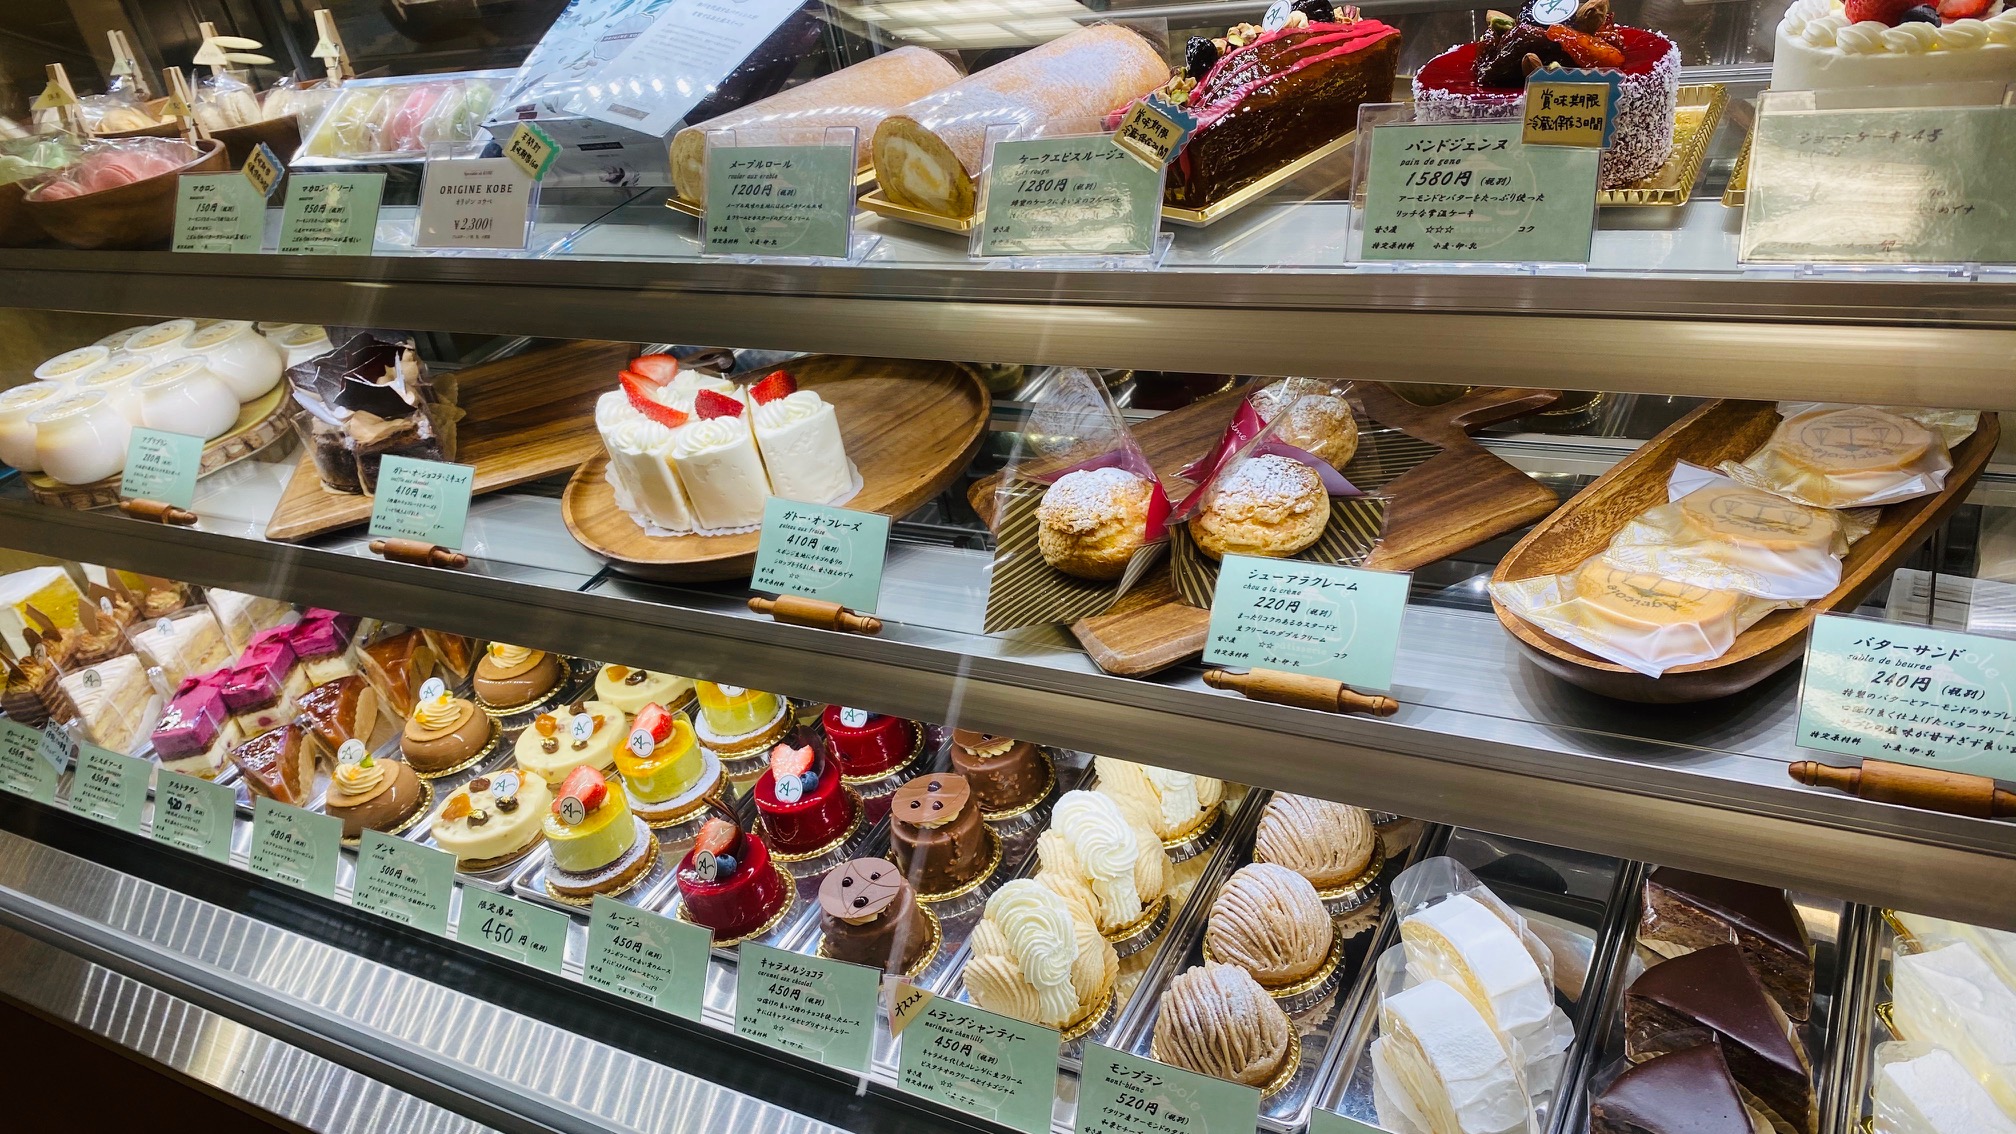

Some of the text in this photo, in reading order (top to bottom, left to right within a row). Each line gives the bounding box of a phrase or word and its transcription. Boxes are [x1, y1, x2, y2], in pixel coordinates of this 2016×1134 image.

[1541, 88, 1601, 111] 賞味期限
[730, 160, 792, 169] メープルロール
[1400, 159, 1420, 168] pain
[1424, 158, 1435, 166] de
[1017, 178, 1068, 192] 1280円
[1405, 171, 1512, 187] 1580円 (税別)
[440, 183, 513, 195] ORIGINE KOBE
[732, 184, 773, 197] 1200円
[196, 203, 218, 212] 150円
[304, 204, 327, 214] 950円
[454, 217, 489, 231] ¥2,300
[1518, 226, 1536, 234] コク
[395, 485, 419, 498] 410円
[784, 511, 863, 531] ガトー・オ・フレーズ
[787, 534, 819, 550] 410円
[1248, 569, 1358, 592] シューアラクレーム
[1243, 583, 1259, 593] chou
[1270, 586, 1278, 594] la
[1279, 587, 1302, 597] crème
[1254, 596, 1333, 618] 220円 (税別)
[1237, 611, 1339, 633] まったりコクのあるカスタードと
[1236, 625, 1327, 643] 生クリームのダブルクリーム
[1333, 651, 1348, 660] コク
[1854, 636, 1967, 662] バターサンド
[1846, 653, 1875, 664] sable
[1879, 656, 1892, 666] de
[1871, 671, 1987, 702] 240円 (税別)
[1810, 731, 1936, 758] 特定原材料 小麦・卵・乳
[270, 829, 292, 843] 480円
[375, 843, 396, 855] ダンセ
[380, 865, 404, 879] 500円
[478, 900, 514, 917] 限定商品
[605, 923, 620, 931] rouge
[609, 912, 641, 929] ルージュ
[481, 917, 514, 944] 450
[518, 935, 528, 946] 円
[612, 935, 643, 954] 450円
[760, 957, 825, 984] キャラメルショコラ
[768, 983, 802, 1002] 450円
[894, 990, 923, 1017] オススメ
[924, 1020, 985, 1045] meringue chantilly
[927, 1009, 1026, 1043] ムラングシャンティー
[933, 1035, 999, 1066] 450円 (税別)
[922, 1048, 1024, 1086] キャラメル化したメレンゲに生クリーム
[1109, 1063, 1165, 1088] モンブラン
[1104, 1076, 1145, 1095] mont-blanc
[1115, 1092, 1160, 1116] 520円
[1164, 1111, 1190, 1126] (税別)
